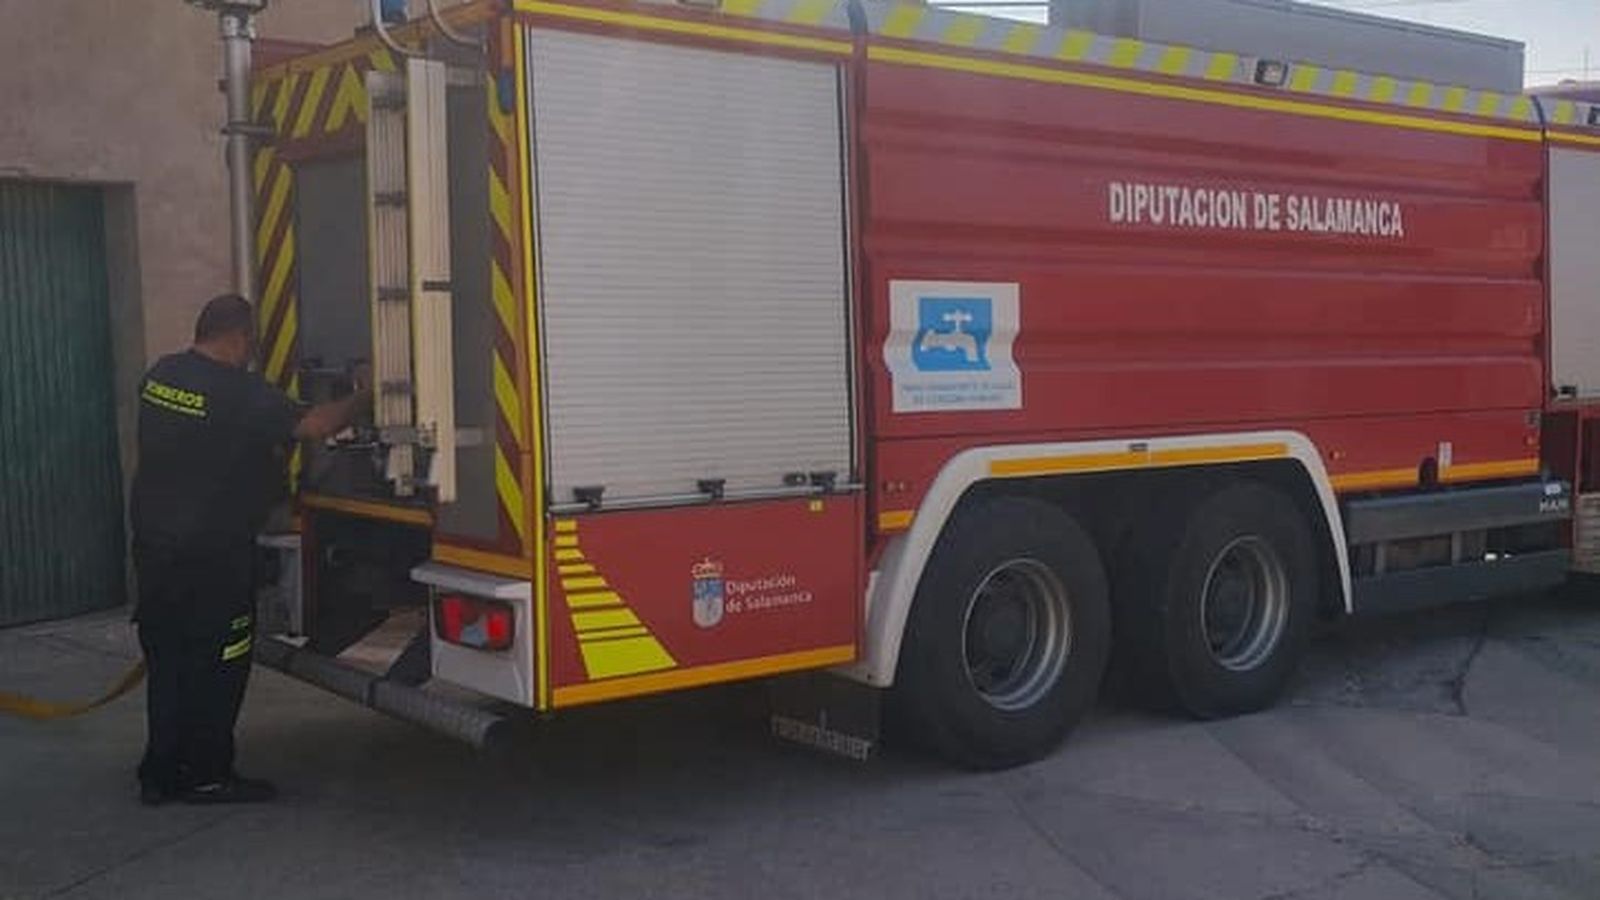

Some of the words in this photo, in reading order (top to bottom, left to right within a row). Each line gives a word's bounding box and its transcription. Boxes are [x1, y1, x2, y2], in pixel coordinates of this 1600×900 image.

[1109, 183, 1247, 229] DIPUTACION
[1254, 193, 1281, 230] DE
[1286, 195, 1403, 236] SALAMANCA
[725, 597, 742, 613] de
[746, 591, 812, 609] Salamanca
